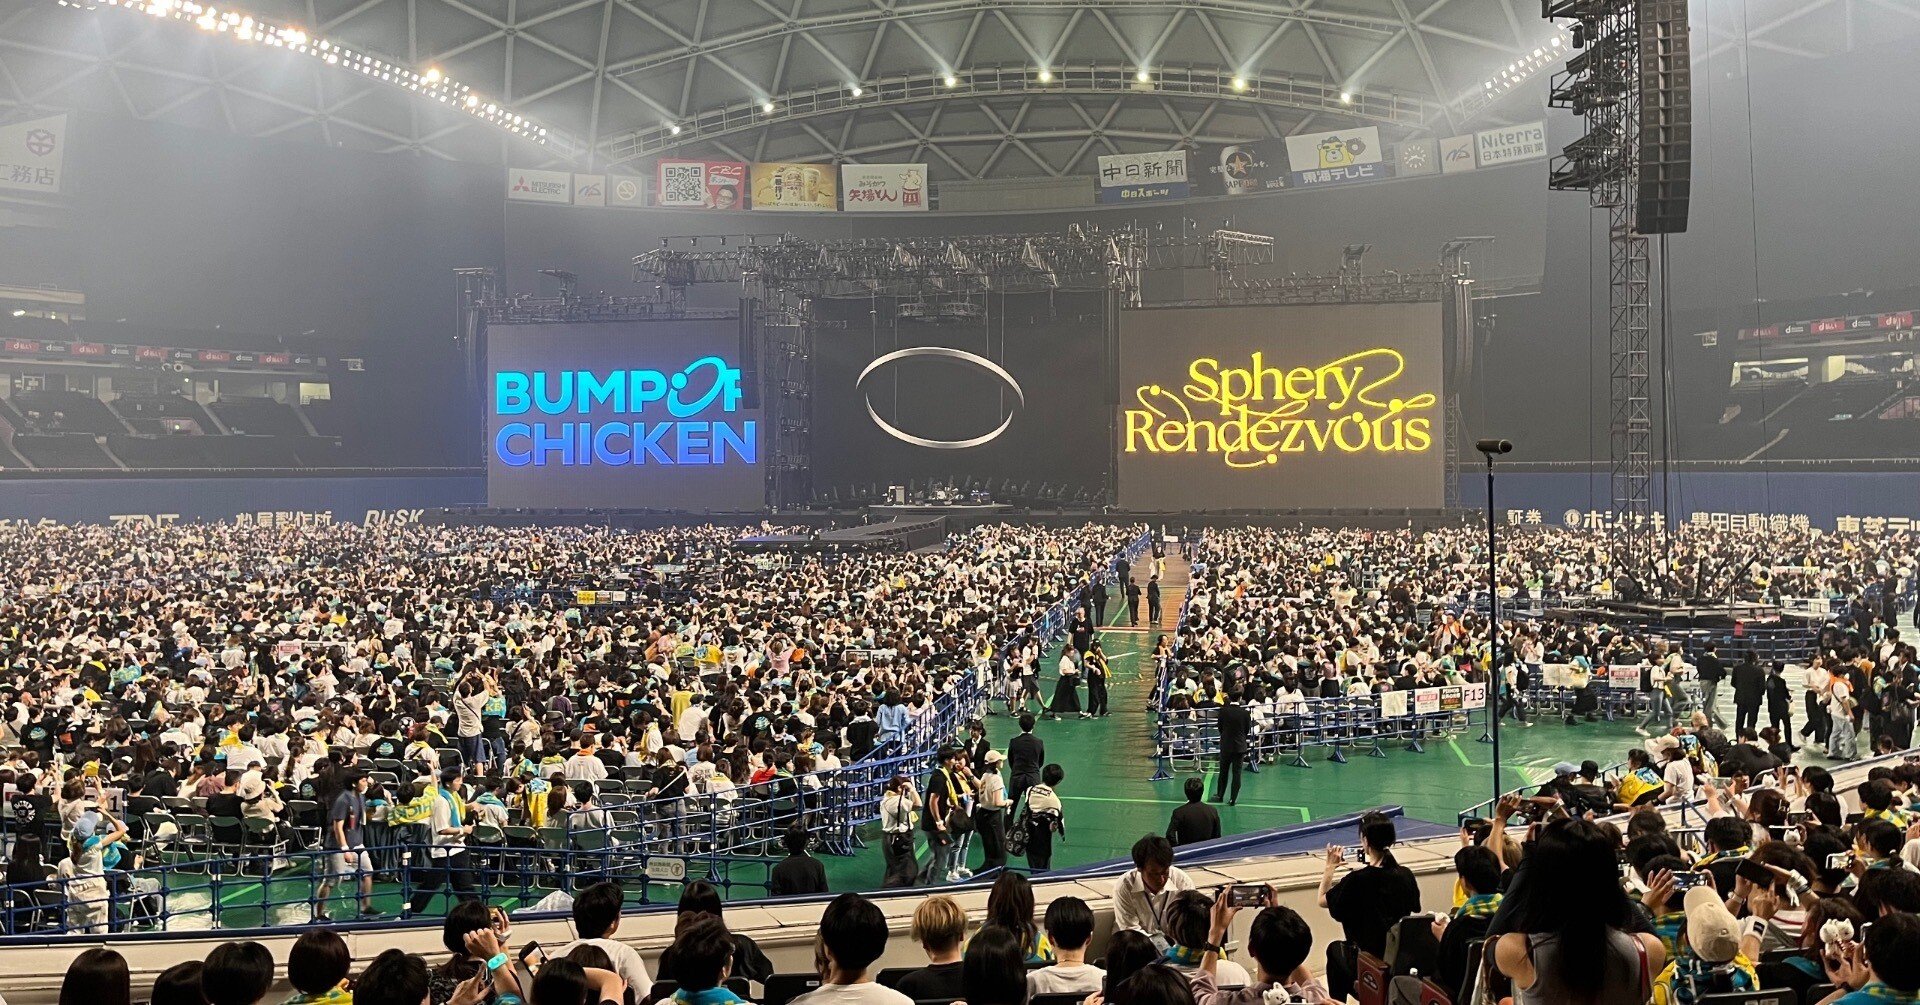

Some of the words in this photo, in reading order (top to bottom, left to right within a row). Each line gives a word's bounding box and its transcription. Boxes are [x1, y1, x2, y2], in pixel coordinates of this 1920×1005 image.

[1481, 128, 1543, 149] Niterra
[708, 165, 742, 175] CBC
[1102, 159, 1184, 181] 中日新聞
[1302, 164, 1374, 184] 東海テレビ
[848, 188, 898, 202] 矢場とん
[496, 369, 668, 415] BUMP
[1183, 349, 1368, 416] Sphery
[1124, 401, 1434, 458] Rendezvous
[495, 420, 757, 467] CHICKEN
[1463, 688, 1485, 702] F13
